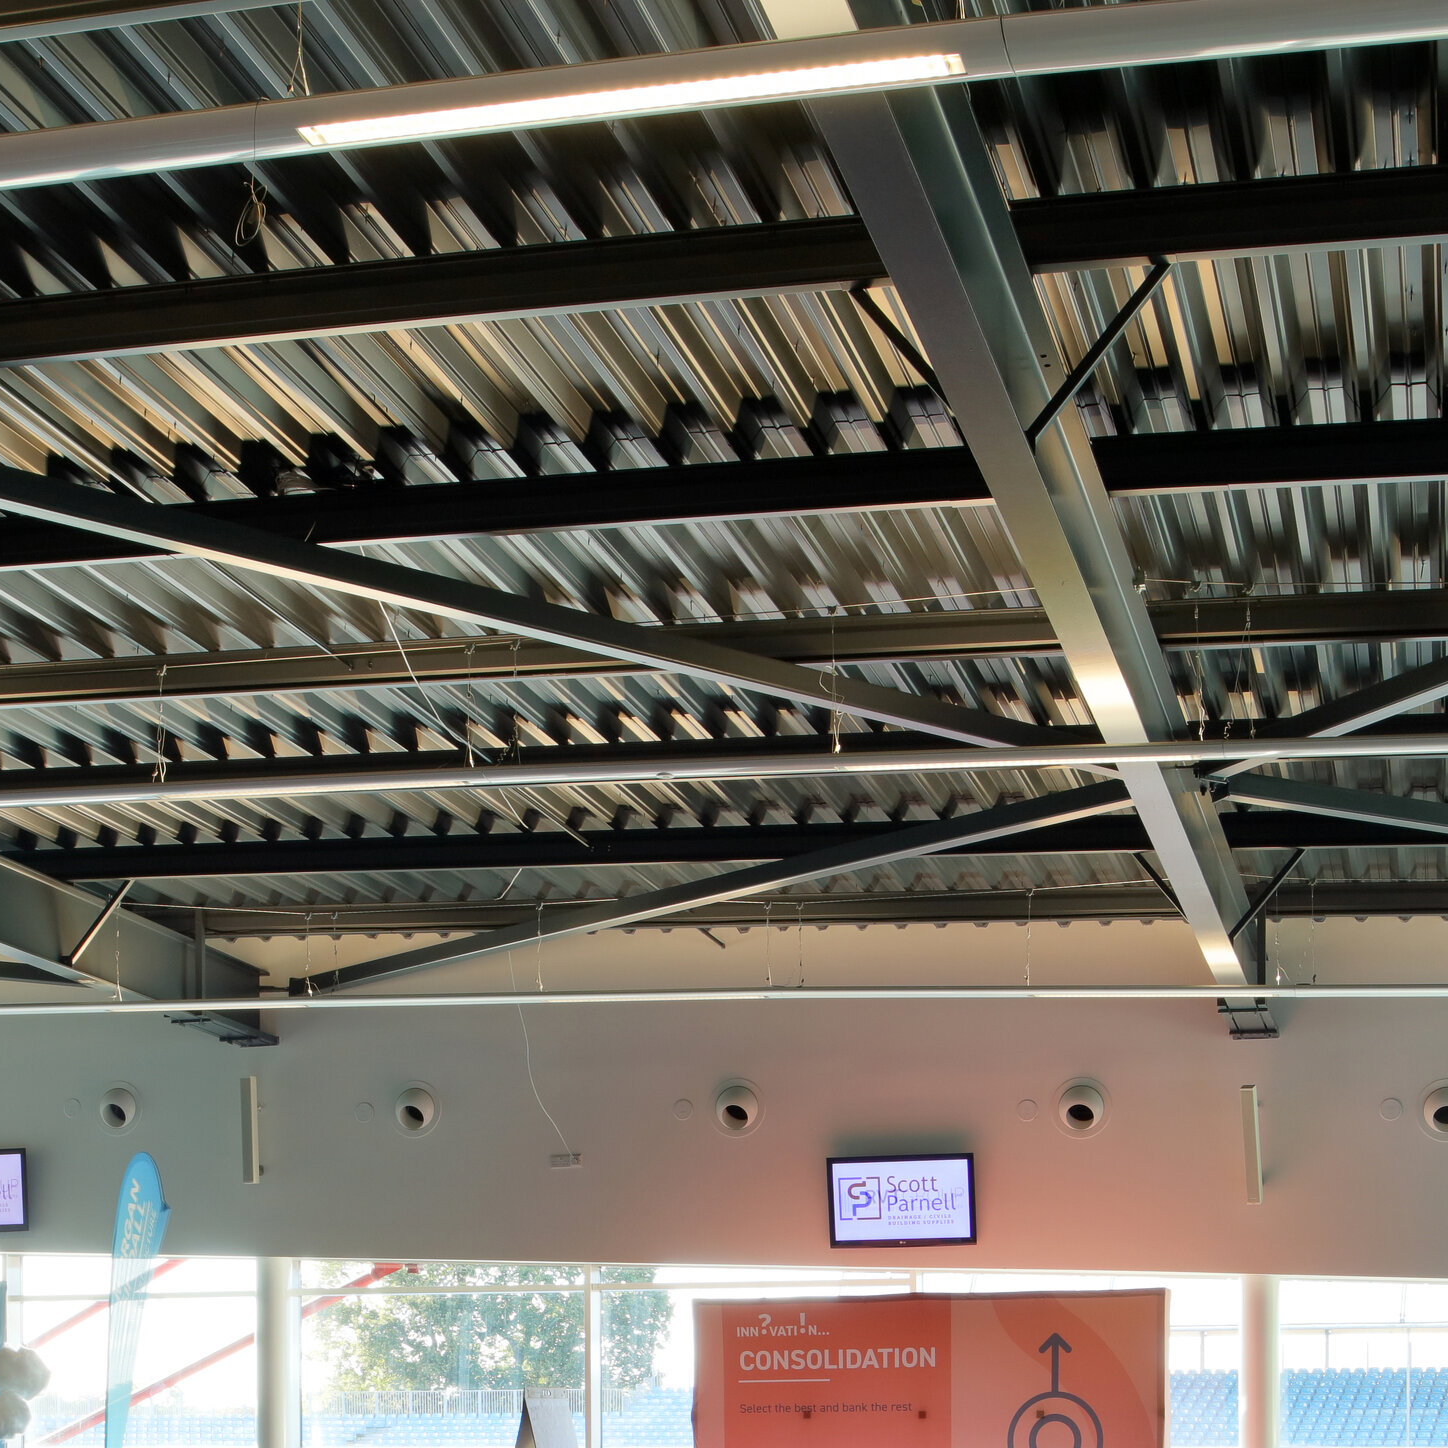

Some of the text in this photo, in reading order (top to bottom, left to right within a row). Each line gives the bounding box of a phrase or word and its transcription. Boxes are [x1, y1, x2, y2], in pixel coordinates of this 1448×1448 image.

[887, 1176, 938, 1193] Scott
[887, 1193, 956, 1212] Parnell
[739, 1347, 936, 1371] CONSOLIDATION
[740, 1403, 912, 1414] Select the best and bank the rest
